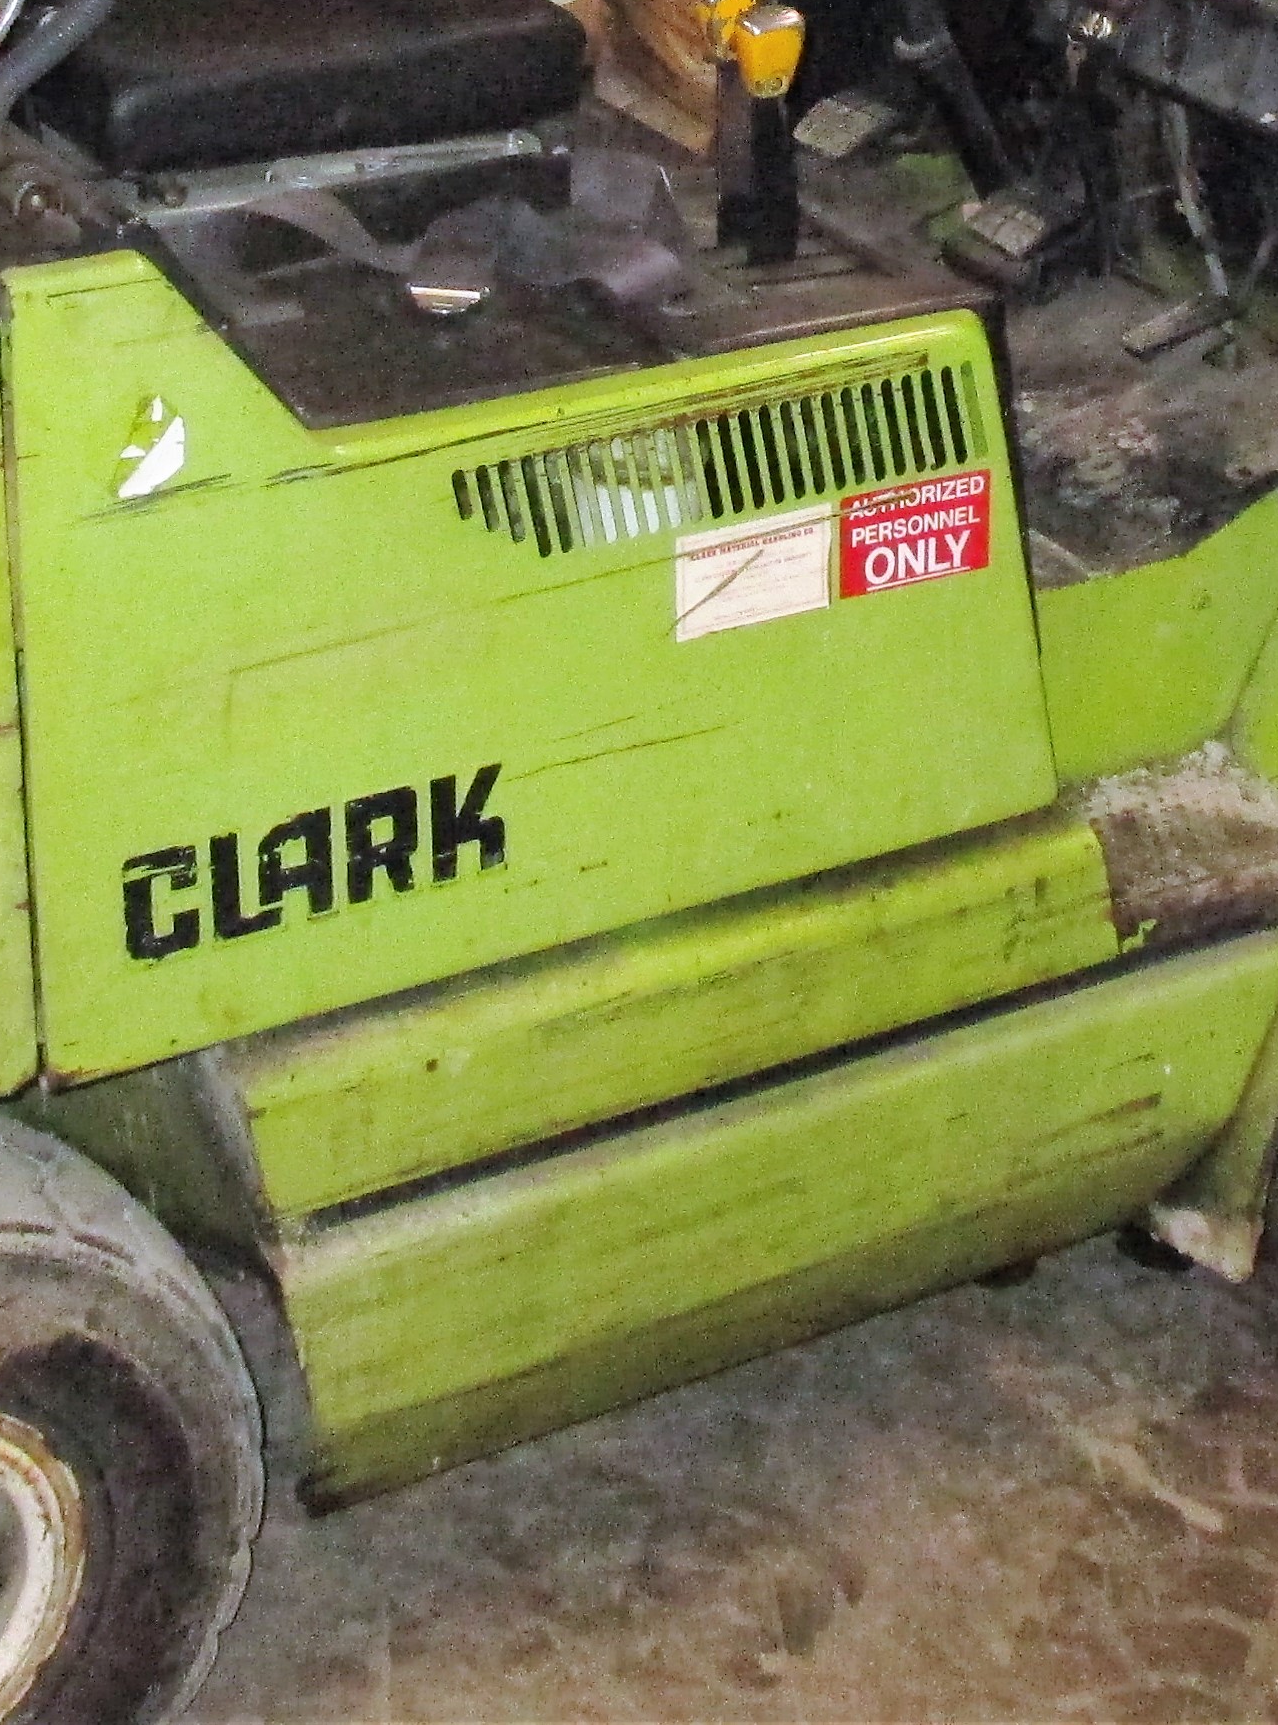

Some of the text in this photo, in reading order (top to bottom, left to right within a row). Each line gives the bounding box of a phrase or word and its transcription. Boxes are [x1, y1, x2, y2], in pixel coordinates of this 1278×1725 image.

[848, 474, 986, 522] AUTHORIZED
[851, 505, 982, 548] PERSONNEL
[864, 529, 972, 586] ONLY
[121, 762, 508, 961] CLARK
